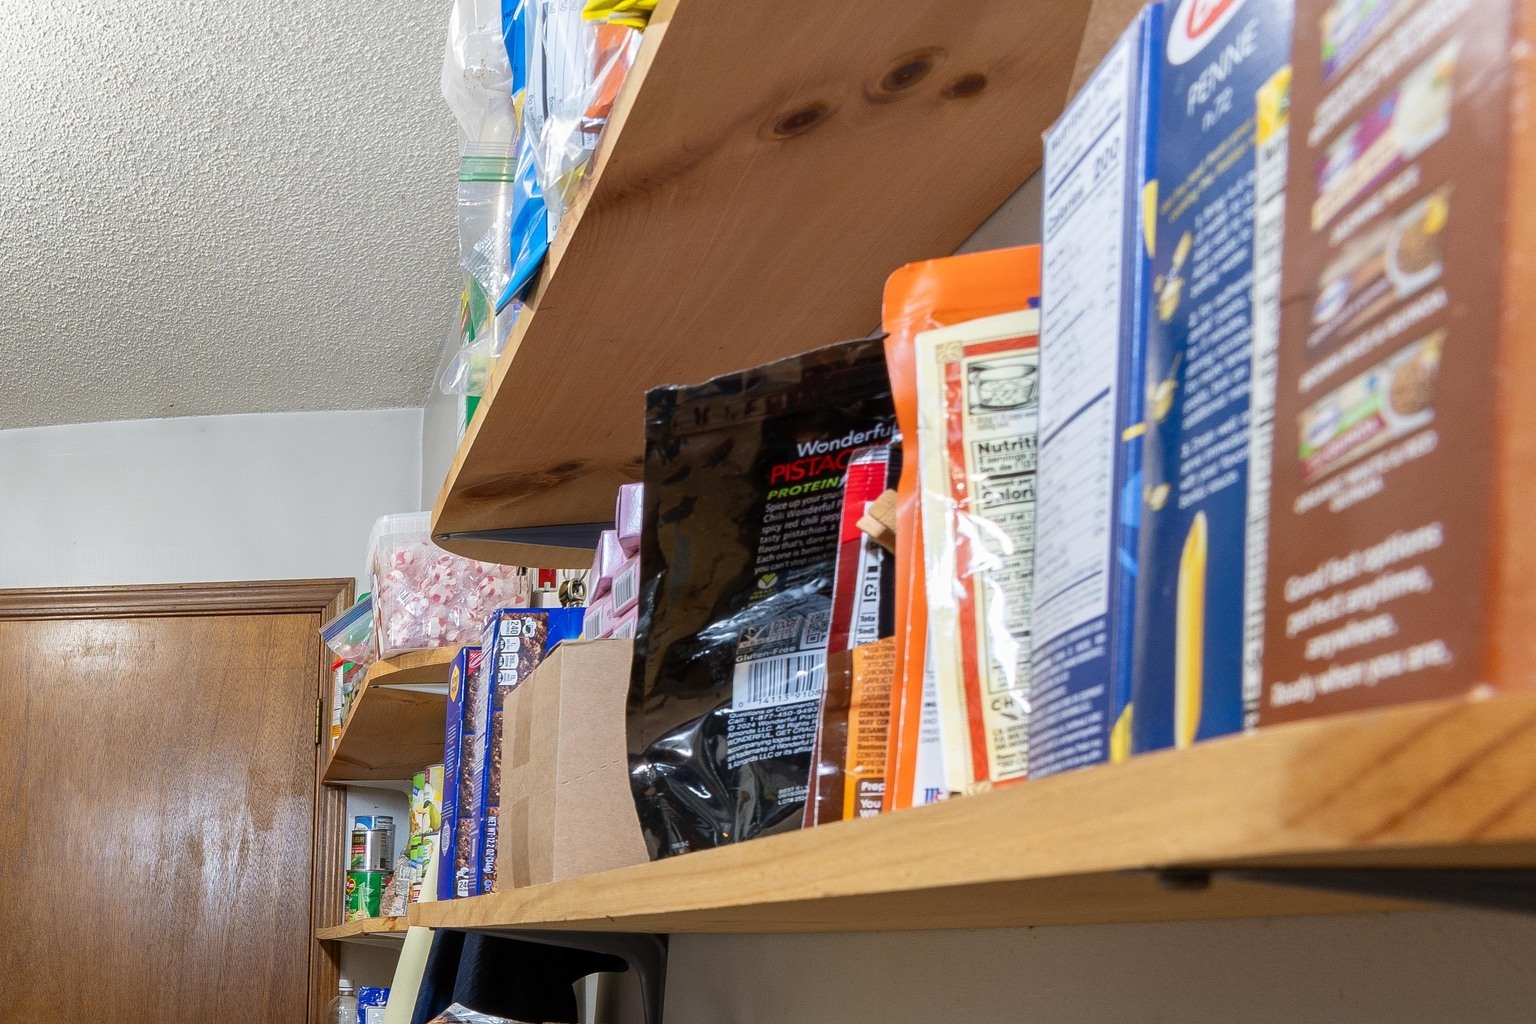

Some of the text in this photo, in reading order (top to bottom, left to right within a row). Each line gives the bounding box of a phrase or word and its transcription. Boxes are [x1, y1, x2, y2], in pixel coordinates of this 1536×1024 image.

[770, 449, 852, 486] PISTAC
[766, 476, 840, 500] PROTEIN
[766, 496, 822, 514] Spice up your
[786, 501, 836, 518] Wonderful
[785, 519, 800, 530] red
[783, 525, 826, 540] pistachios
[1364, 521, 1444, 572] options
[757, 551, 794, 564] Each one
[510, 621, 520, 634] 240
[735, 646, 796, 662] Gluten-Free
[1364, 651, 1402, 688] you
[729, 710, 764, 720] Questions
[758, 717, 798, 726] Wonderful
[727, 729, 756, 740] Almonds
[775, 729, 792, 738] GET
[727, 734, 806, 754] accompanying logos and
[769, 744, 776, 752] of
[777, 739, 810, 750] Wonderful
[733, 756, 758, 768] Almonds
[759, 752, 774, 760] LLC
[859, 799, 882, 810] You
[486, 816, 496, 856] NET WT 12.2 OZ
